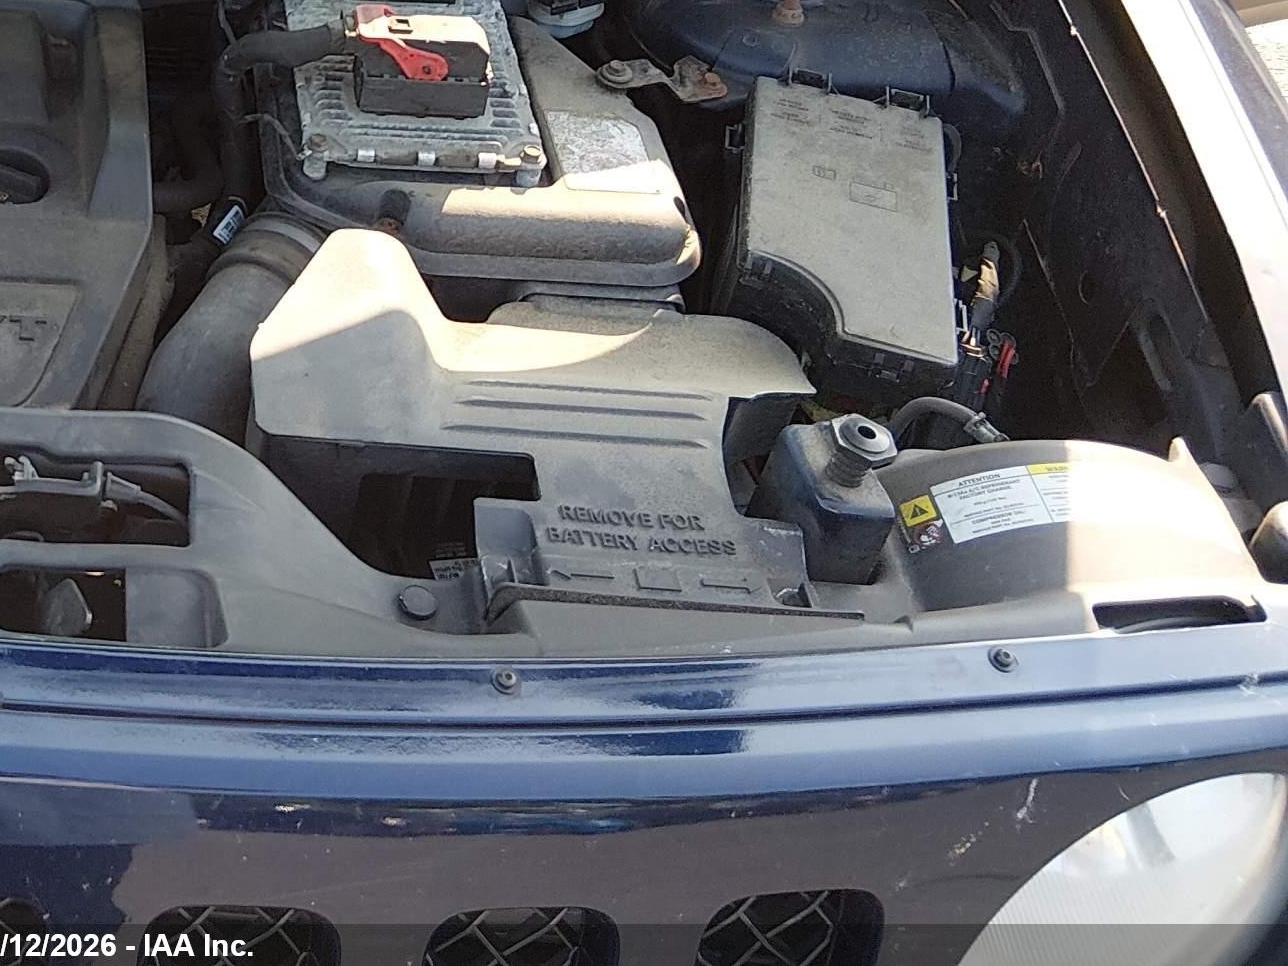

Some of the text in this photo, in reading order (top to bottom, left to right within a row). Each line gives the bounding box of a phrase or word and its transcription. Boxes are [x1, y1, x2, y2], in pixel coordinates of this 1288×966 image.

[958, 473, 1000, 487] ATTENTION
[557, 505, 705, 530] REMOVE FOR
[545, 527, 737, 556] BATTERY ACCESS
